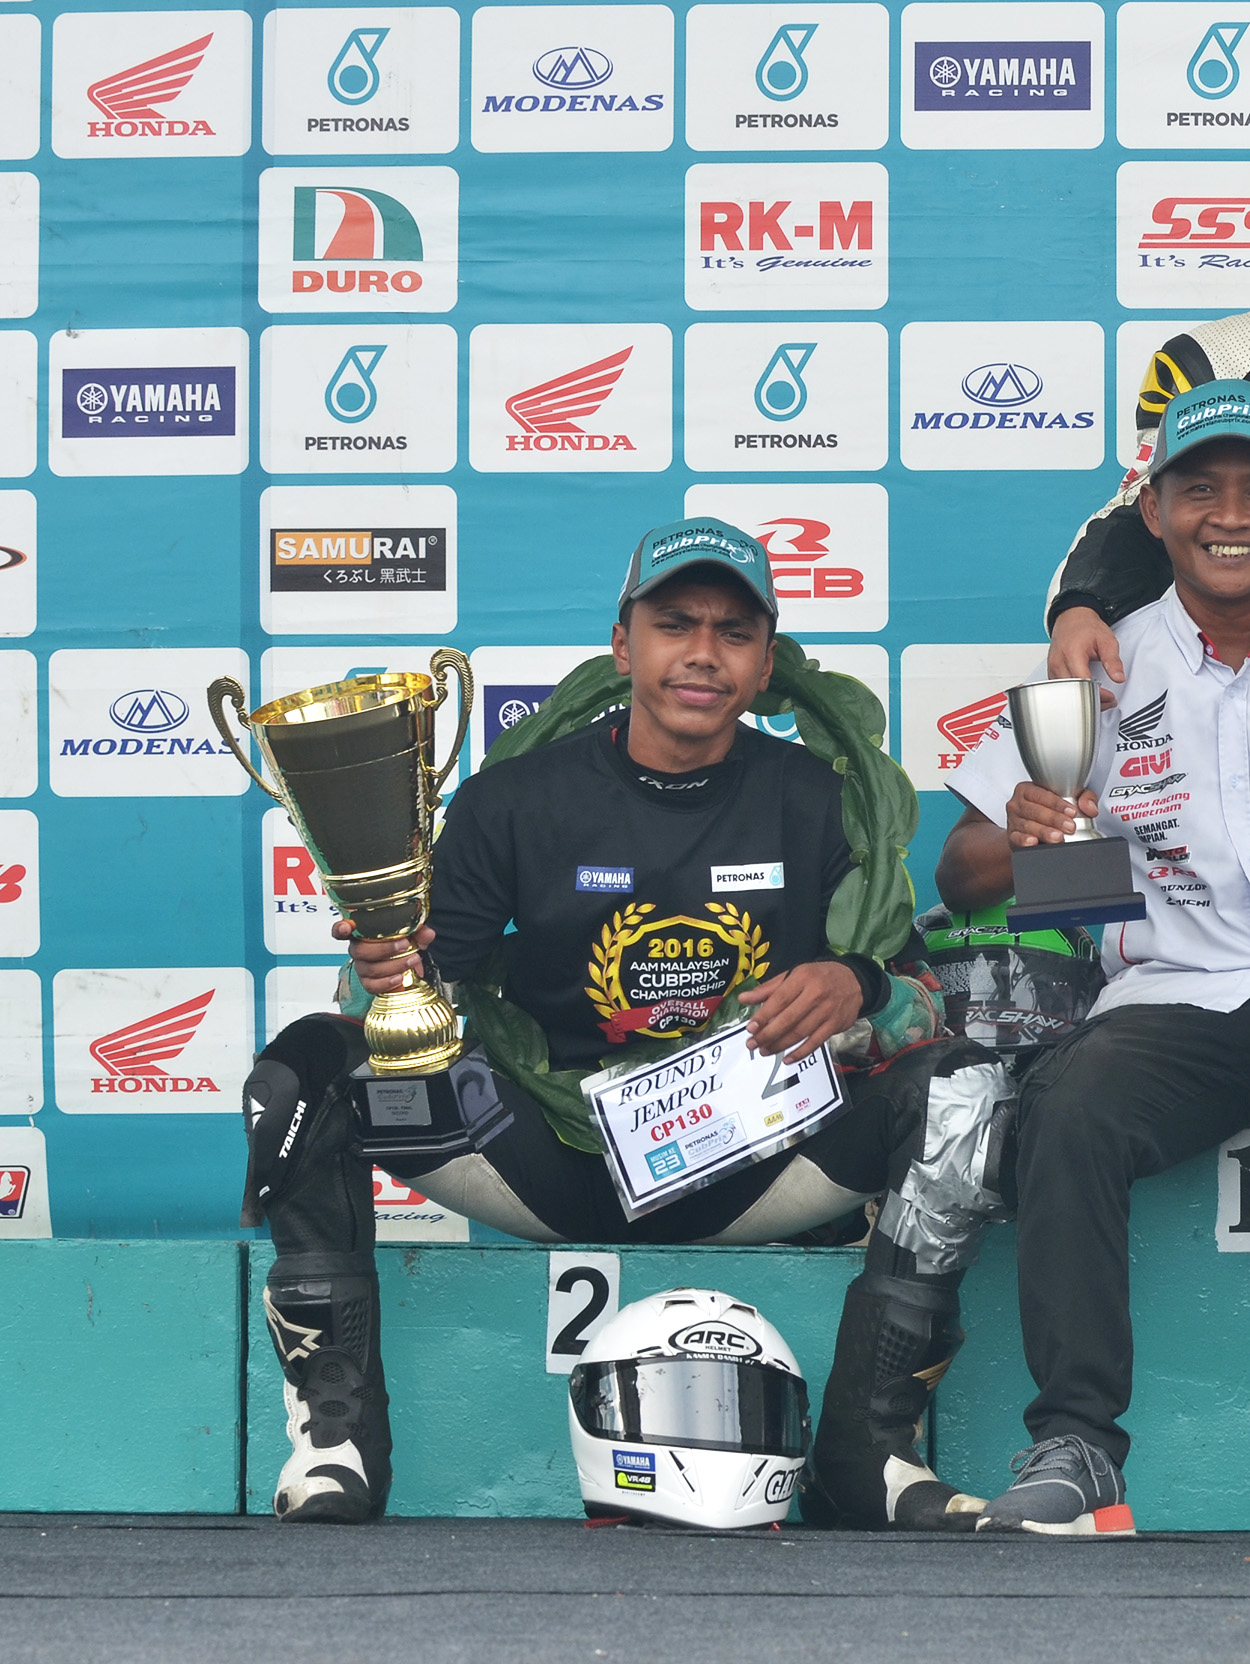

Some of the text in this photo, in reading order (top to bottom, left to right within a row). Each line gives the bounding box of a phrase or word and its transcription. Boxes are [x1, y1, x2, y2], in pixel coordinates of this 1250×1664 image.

[963, 58, 1075, 87] YAMAHA
[941, 88, 1068, 97] RACING
[482, 95, 663, 112] MODENAS
[87, 121, 216, 137] HONDA
[308, 118, 409, 131] PETRONAS
[736, 114, 838, 128] PETRONAS
[700, 201, 872, 251] RK-M
[701, 256, 872, 271] It's Genuine
[1139, 255, 1185, 267] It's
[293, 271, 422, 292] DURO
[110, 384, 220, 412] YAMAHA
[1177, 394, 1246, 419] PETRONAS
[89, 415, 212, 423] RACING
[911, 412, 1094, 429] MODENAS
[305, 436, 407, 450] PETRONAS
[506, 435, 636, 452] HONDA
[735, 434, 837, 448] PETRONAS
[652, 527, 724, 549] PETRONAS
[652, 535, 737, 558] CubPrix
[277, 537, 427, 561] SAMURAI
[771, 568, 864, 598] CB
[60, 738, 240, 756] MODENAS
[1116, 733, 1174, 753] HONDA
[1120, 749, 1171, 777] GIVI
[1110, 792, 1191, 815] Honda Racing
[1131, 803, 1182, 820] Vietnam
[1134, 818, 1180, 836] SEMANGAT.
[592, 871, 631, 885] YAMAHA
[716, 872, 765, 883] PETRONAS
[274, 901, 317, 912] It's
[648, 938, 714, 958] 2016
[630, 958, 730, 972] AAM MALAYSIAN
[639, 969, 720, 988] CUBPRIX
[630, 980, 726, 1000] CHAMPIONSHIP
[648, 1007, 709, 1025] CHAMPION
[651, 1000, 706, 1015] OVERALL
[659, 1015, 697, 1030] CP130
[966, 1009, 1065, 1031] RACSHAW
[798, 1052, 818, 1074] nd
[91, 1077, 220, 1093] HONDA
[618, 1045, 723, 1107] ROUND 9
[631, 1073, 723, 1133] JEMPOL
[278, 1099, 307, 1158] TAICHI
[650, 1103, 713, 1142] CP130
[684, 1130, 719, 1150] PETRONAS
[653, 1155, 682, 1177] 23
[374, 1211, 446, 1224] acing
[551, 1266, 610, 1356] 2
[683, 1330, 746, 1347] ARC
[622, 1455, 650, 1467] YAMAHA
